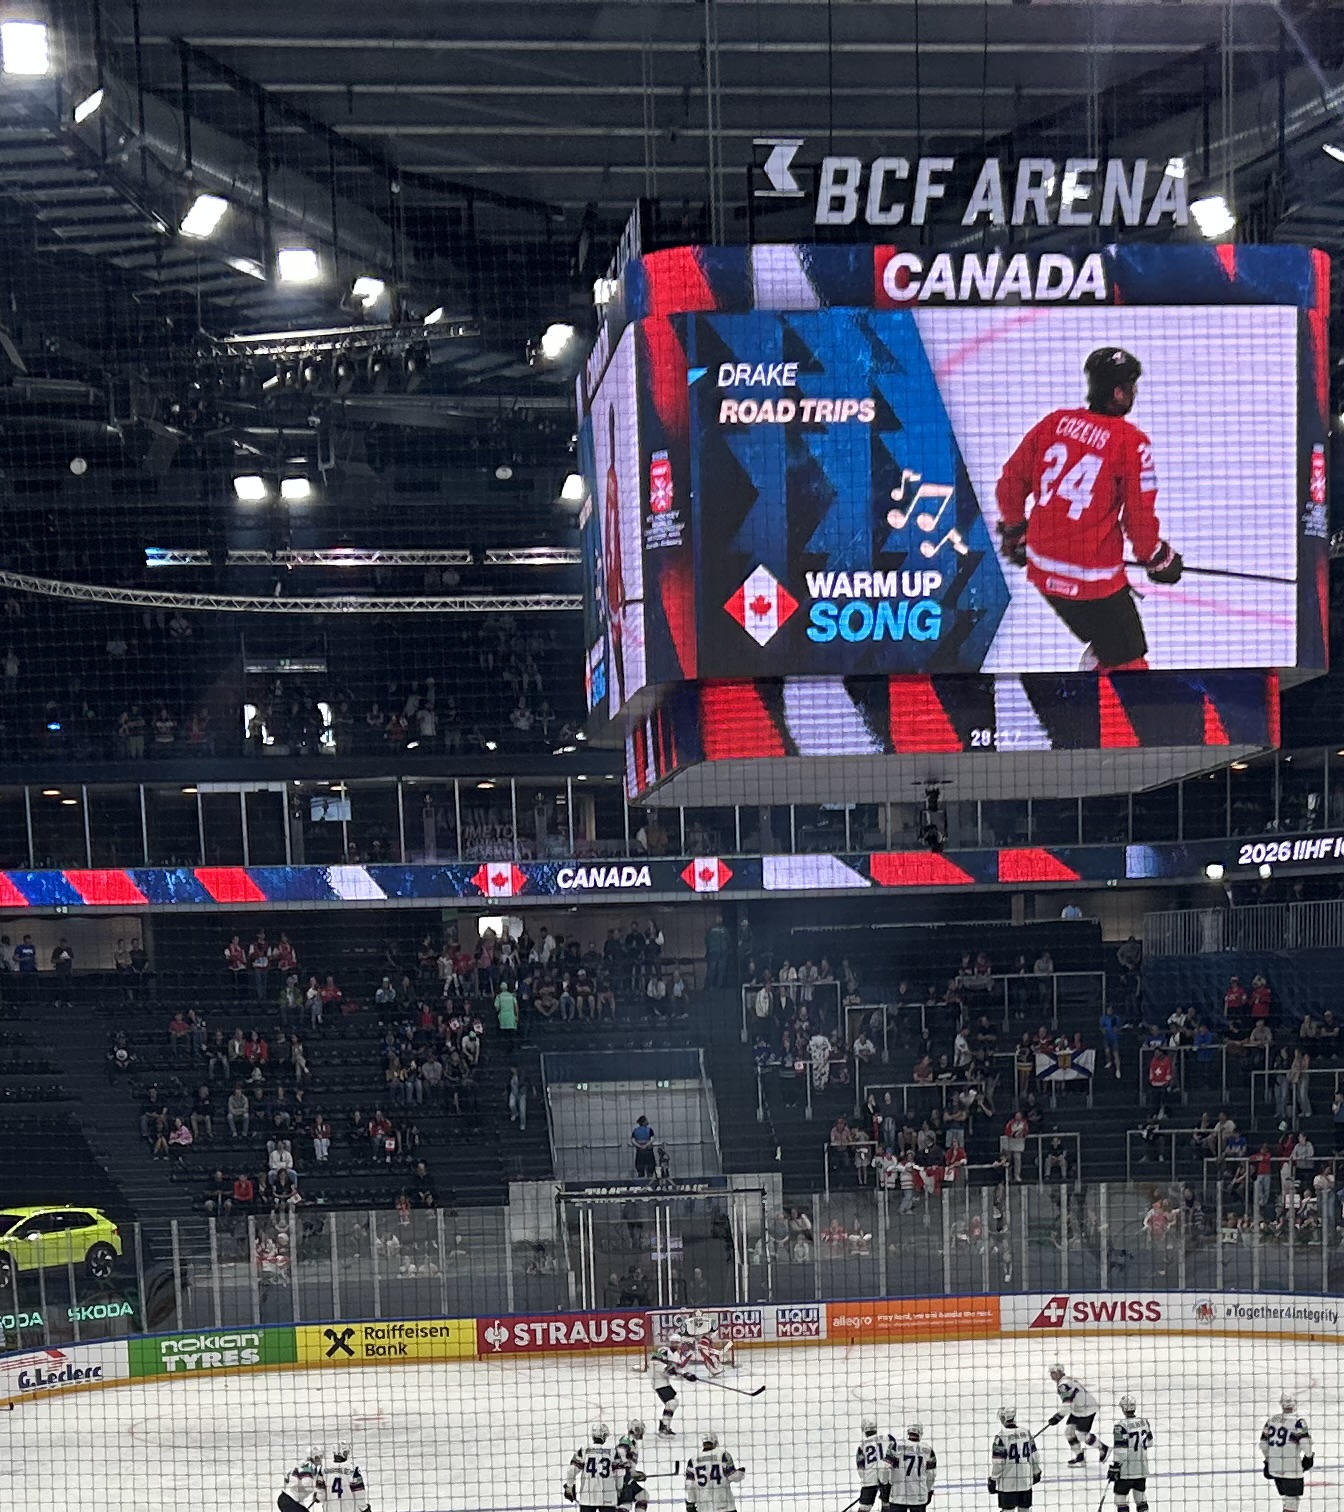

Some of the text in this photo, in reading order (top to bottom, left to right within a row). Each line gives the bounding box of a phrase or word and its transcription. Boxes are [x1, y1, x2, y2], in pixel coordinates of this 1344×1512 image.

[814, 155, 1190, 227] BCF ARENA
[882, 252, 1108, 302] CANADA
[717, 362, 800, 388] DRAKE
[719, 399, 876, 424] ROAD TRIPS
[1056, 415, 1112, 450] COZENS
[1038, 441, 1105, 521] 24
[806, 572, 943, 599] WARM UP
[806, 600, 943, 643] SONG
[1237, 842, 1293, 866] 2026
[556, 864, 652, 890] CANADA
[719, 1309, 762, 1325] LIQUI
[776, 1307, 819, 1324] LIQUI
[832, 1315, 873, 1329] allegro
[1071, 1300, 1162, 1324] SWISS
[1225, 1304, 1339, 1324] #Together4Integrity
[363, 1323, 451, 1342] Raiffeisen
[513, 1317, 645, 1345] STRAUSS
[719, 1324, 762, 1340] MOLY
[776, 1322, 819, 1338] MOLY
[161, 1348, 260, 1372] TYRES
[364, 1339, 409, 1358] Bank
[865, 1442, 885, 1465] 21
[1007, 1441, 1032, 1464] 44
[585, 1457, 612, 1479] 43
[695, 1463, 723, 1488] 54
[902, 1454, 924, 1477] 71
[331, 1477, 344, 1499] 4
